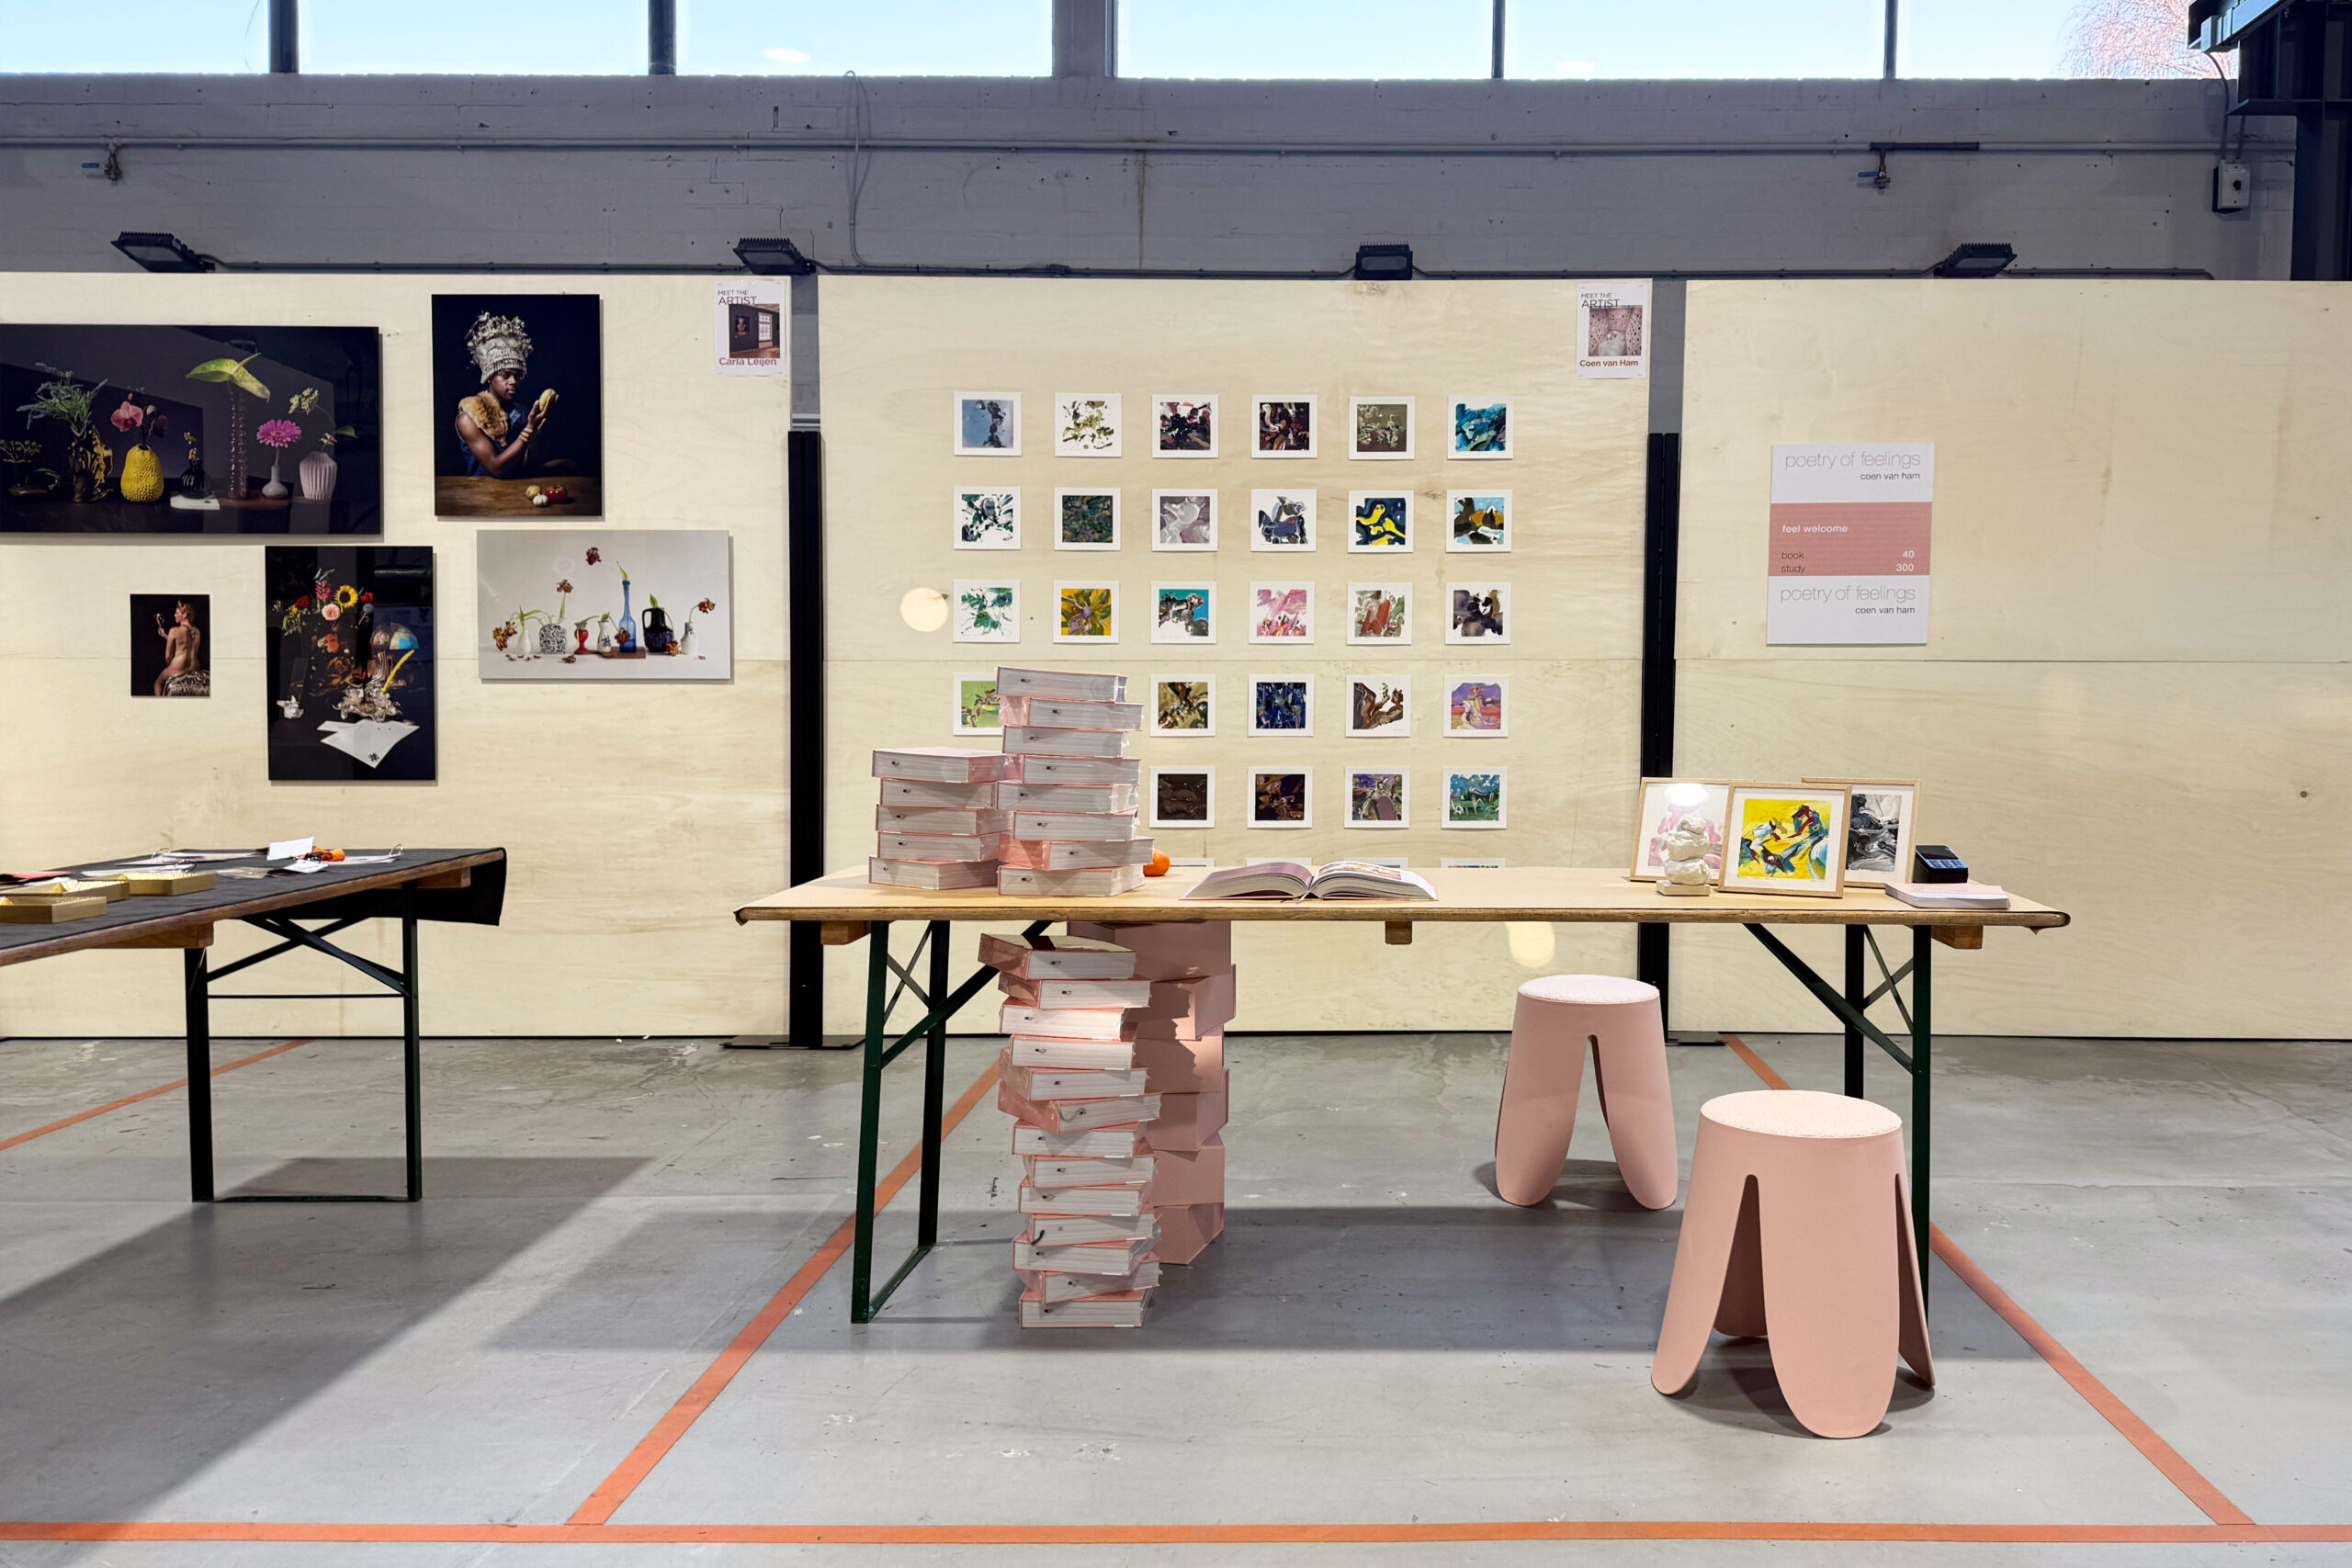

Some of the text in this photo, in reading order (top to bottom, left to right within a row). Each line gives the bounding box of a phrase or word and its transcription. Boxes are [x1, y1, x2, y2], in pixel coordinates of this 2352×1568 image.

[718, 296, 757, 305] ARTIST
[1581, 299, 1620, 308] ARTIST
[718, 357, 777, 367] Carla Leijen
[1785, 451, 1921, 469] poetry of feelings
[1781, 525, 1849, 534] feel welcome
[1781, 550, 1915, 559] book 40
[1781, 563, 1915, 574] study 300
[1781, 585, 1917, 604] poetry of feelings
[1855, 605, 1916, 615] coen van ham
